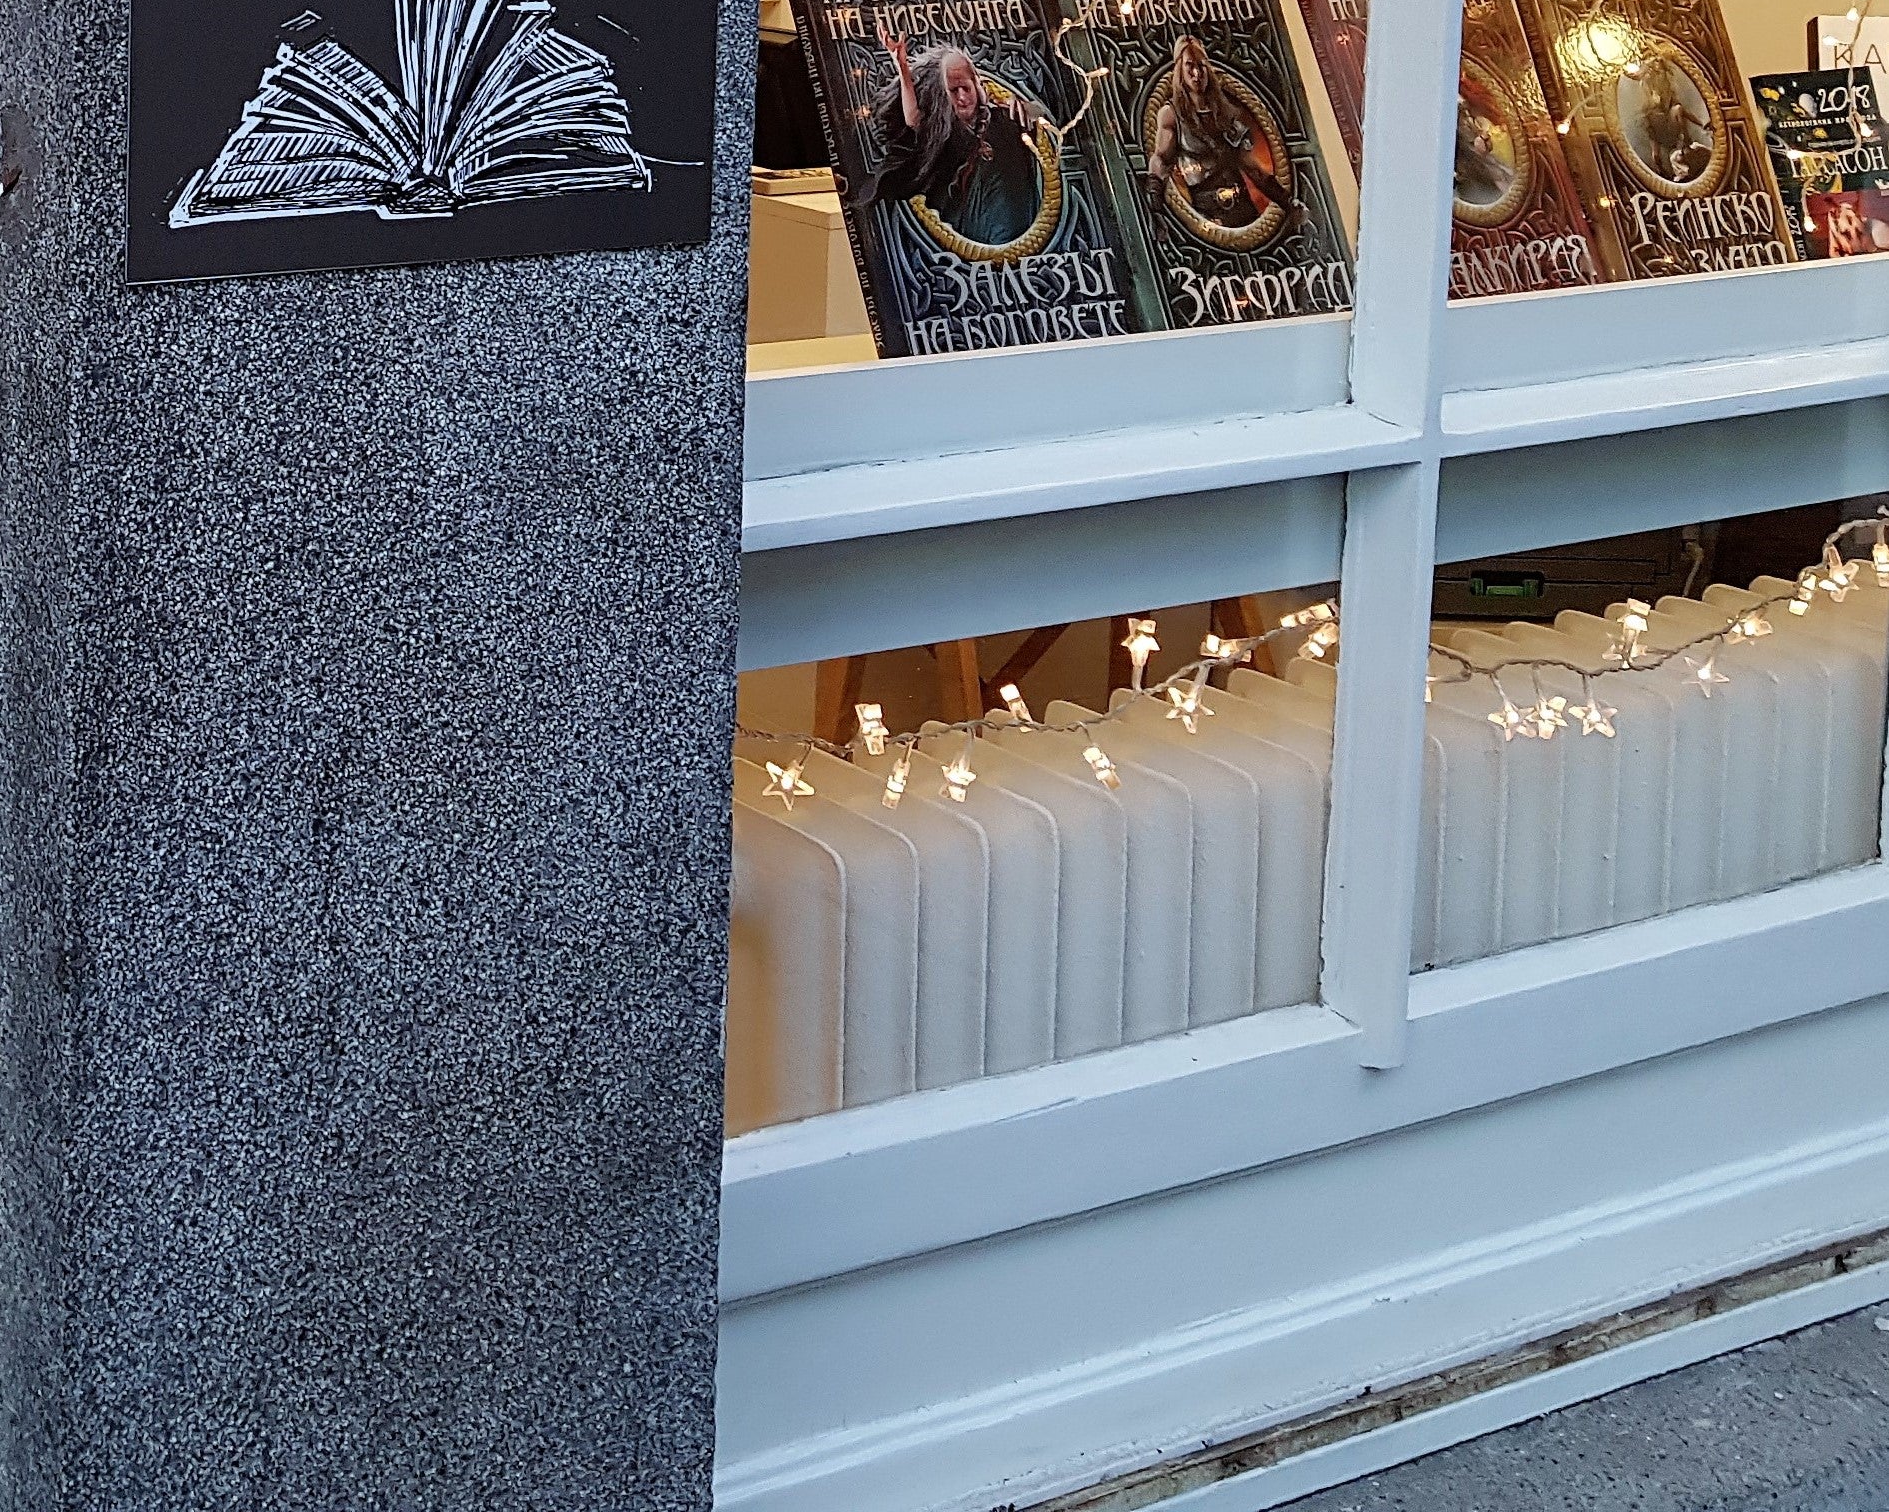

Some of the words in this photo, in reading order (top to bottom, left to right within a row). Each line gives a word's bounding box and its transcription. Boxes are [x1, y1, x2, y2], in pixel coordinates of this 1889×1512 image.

[824, 6, 873, 40] НА
[873, 0, 1028, 37] НИБЕЛУНГА
[1075, 0, 1114, 30] НА
[1817, 84, 1871, 113] 2018
[1630, 191, 1775, 246] РЕЙНСКО
[931, 247, 1115, 313] ЗАЛЕЗЪТ
[904, 316, 953, 356] НА
[959, 299, 1130, 350] БОГОВЕТЕ
